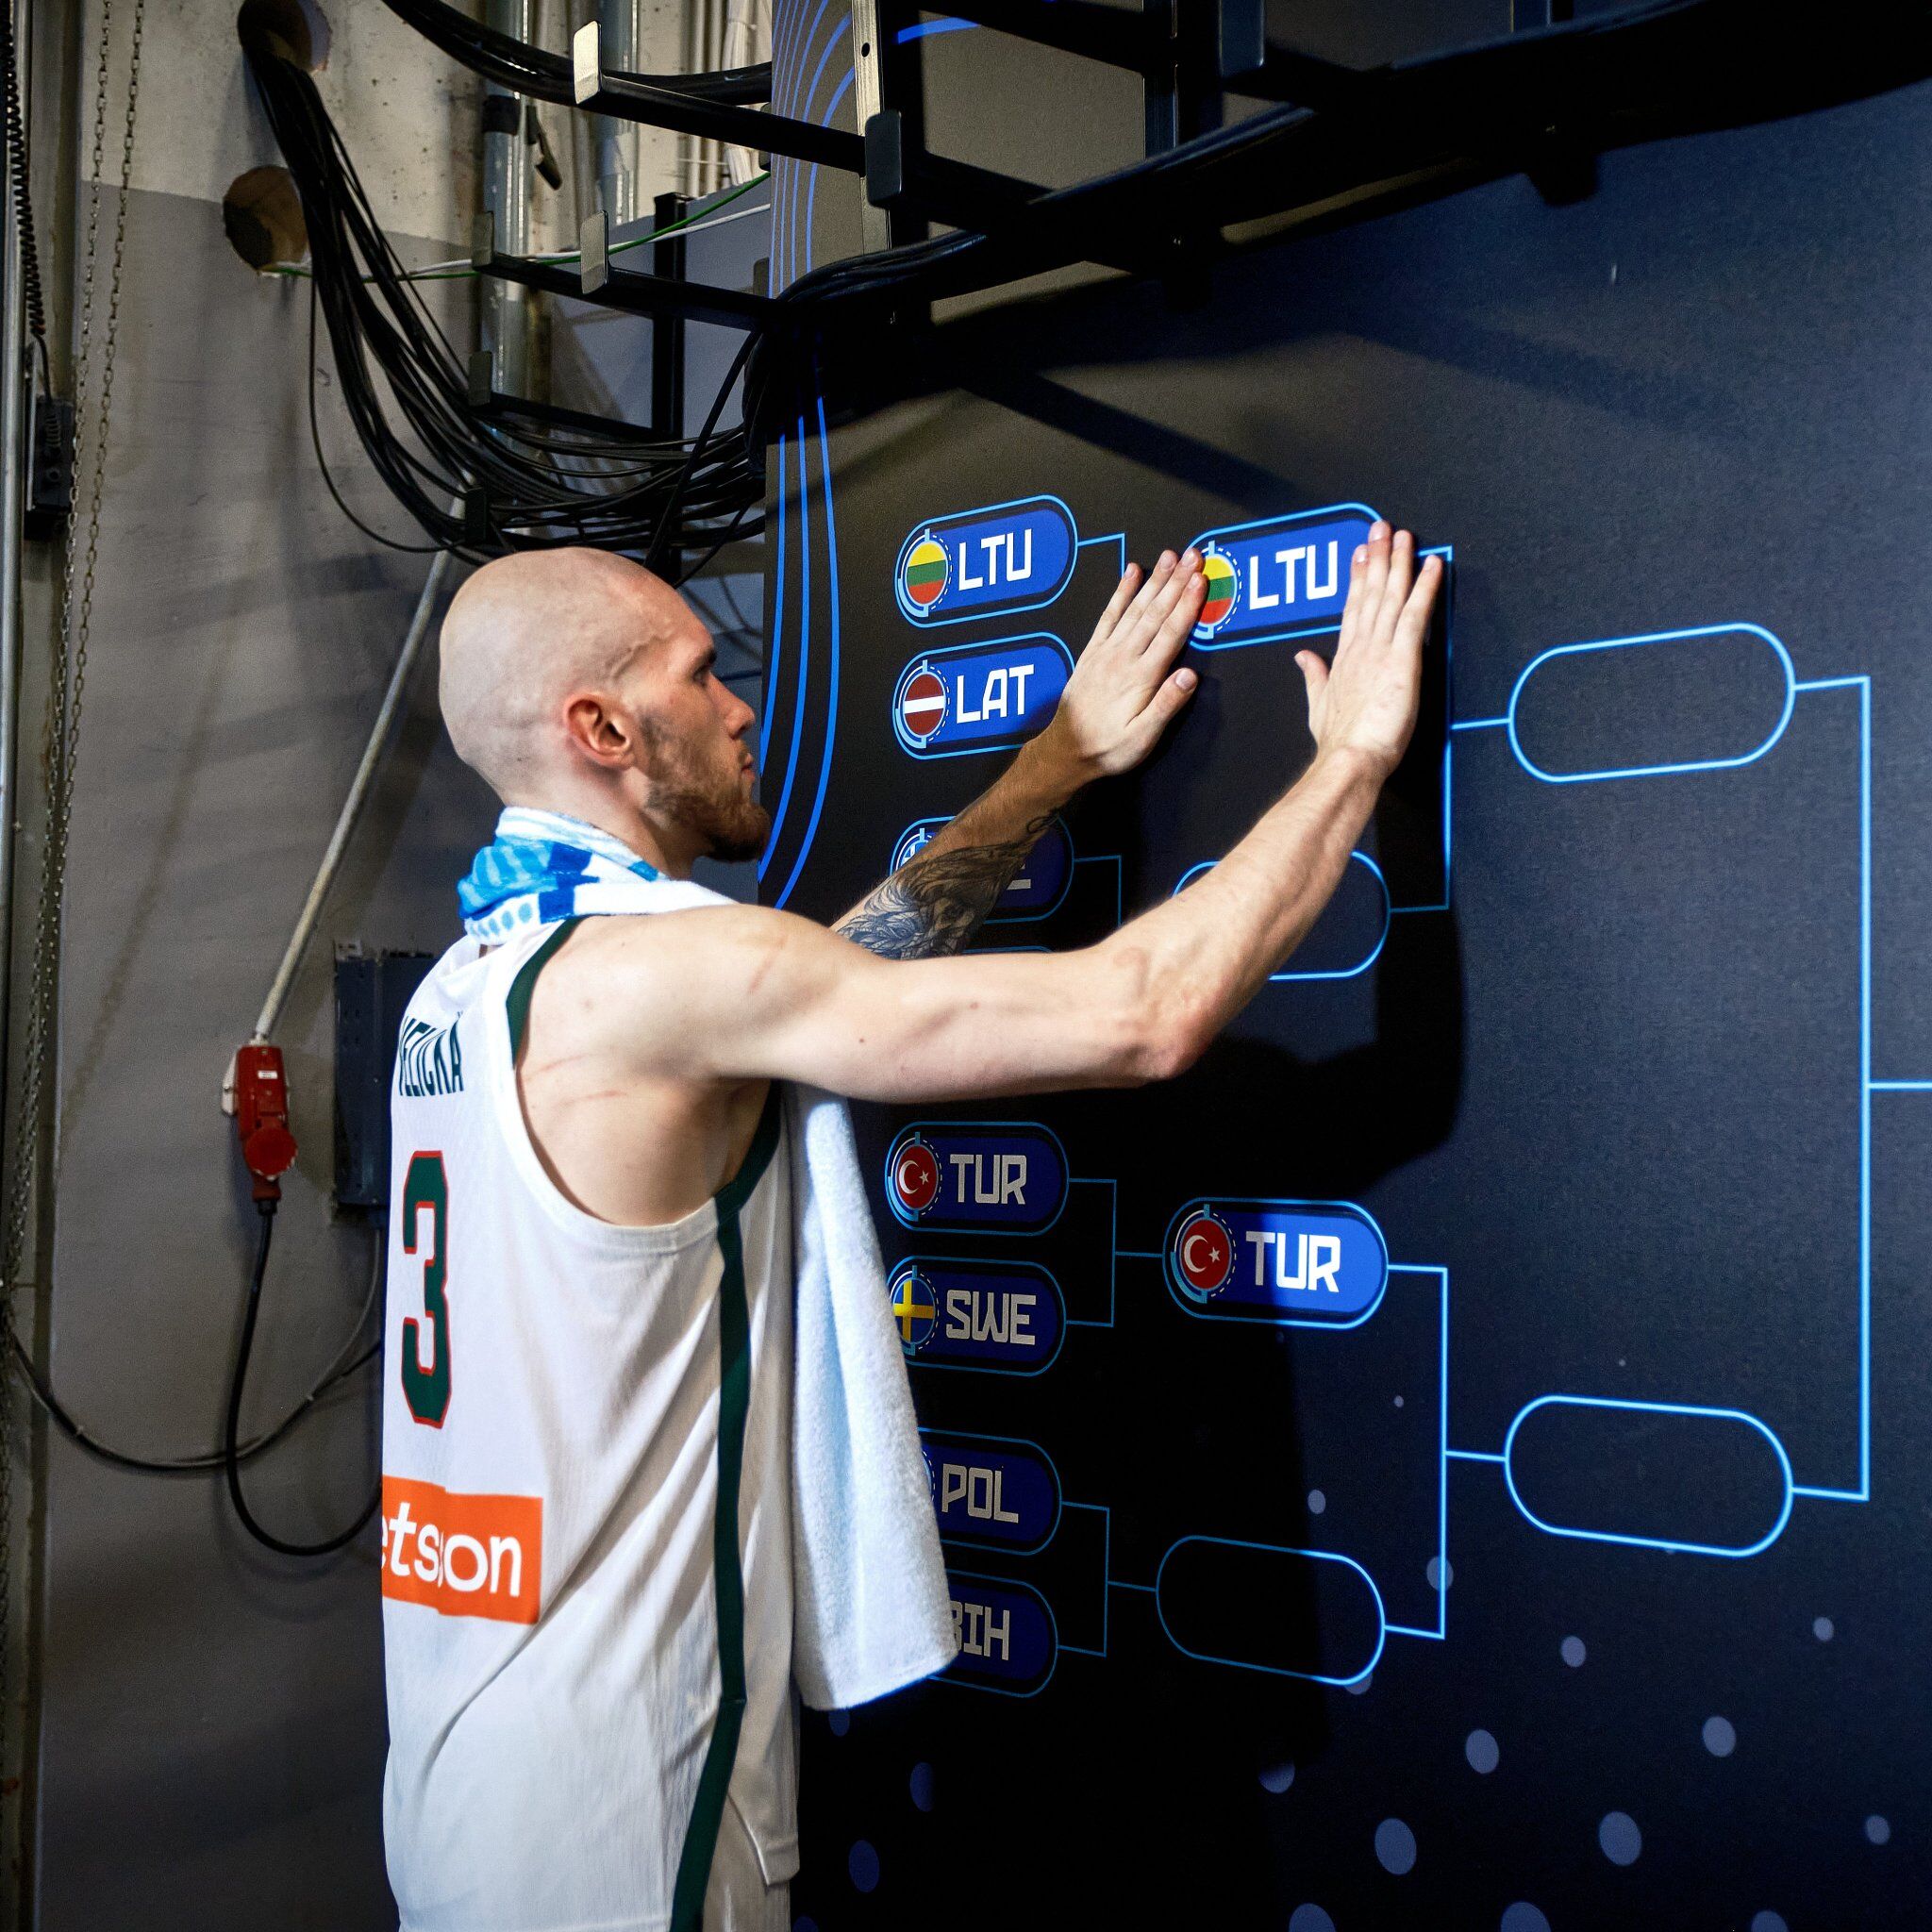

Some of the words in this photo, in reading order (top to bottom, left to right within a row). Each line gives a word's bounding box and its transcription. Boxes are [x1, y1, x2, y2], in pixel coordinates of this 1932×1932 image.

[958, 528, 1032, 591] LTU
[1250, 541, 1338, 610] LTU
[957, 664, 1034, 724] LAT
[950, 1154, 1026, 1205] TUR
[402, 1150, 452, 1429] 3
[1245, 1231, 1341, 1292] TUR
[946, 1290, 1036, 1345] SWE
[941, 1463, 1019, 1524] POL
